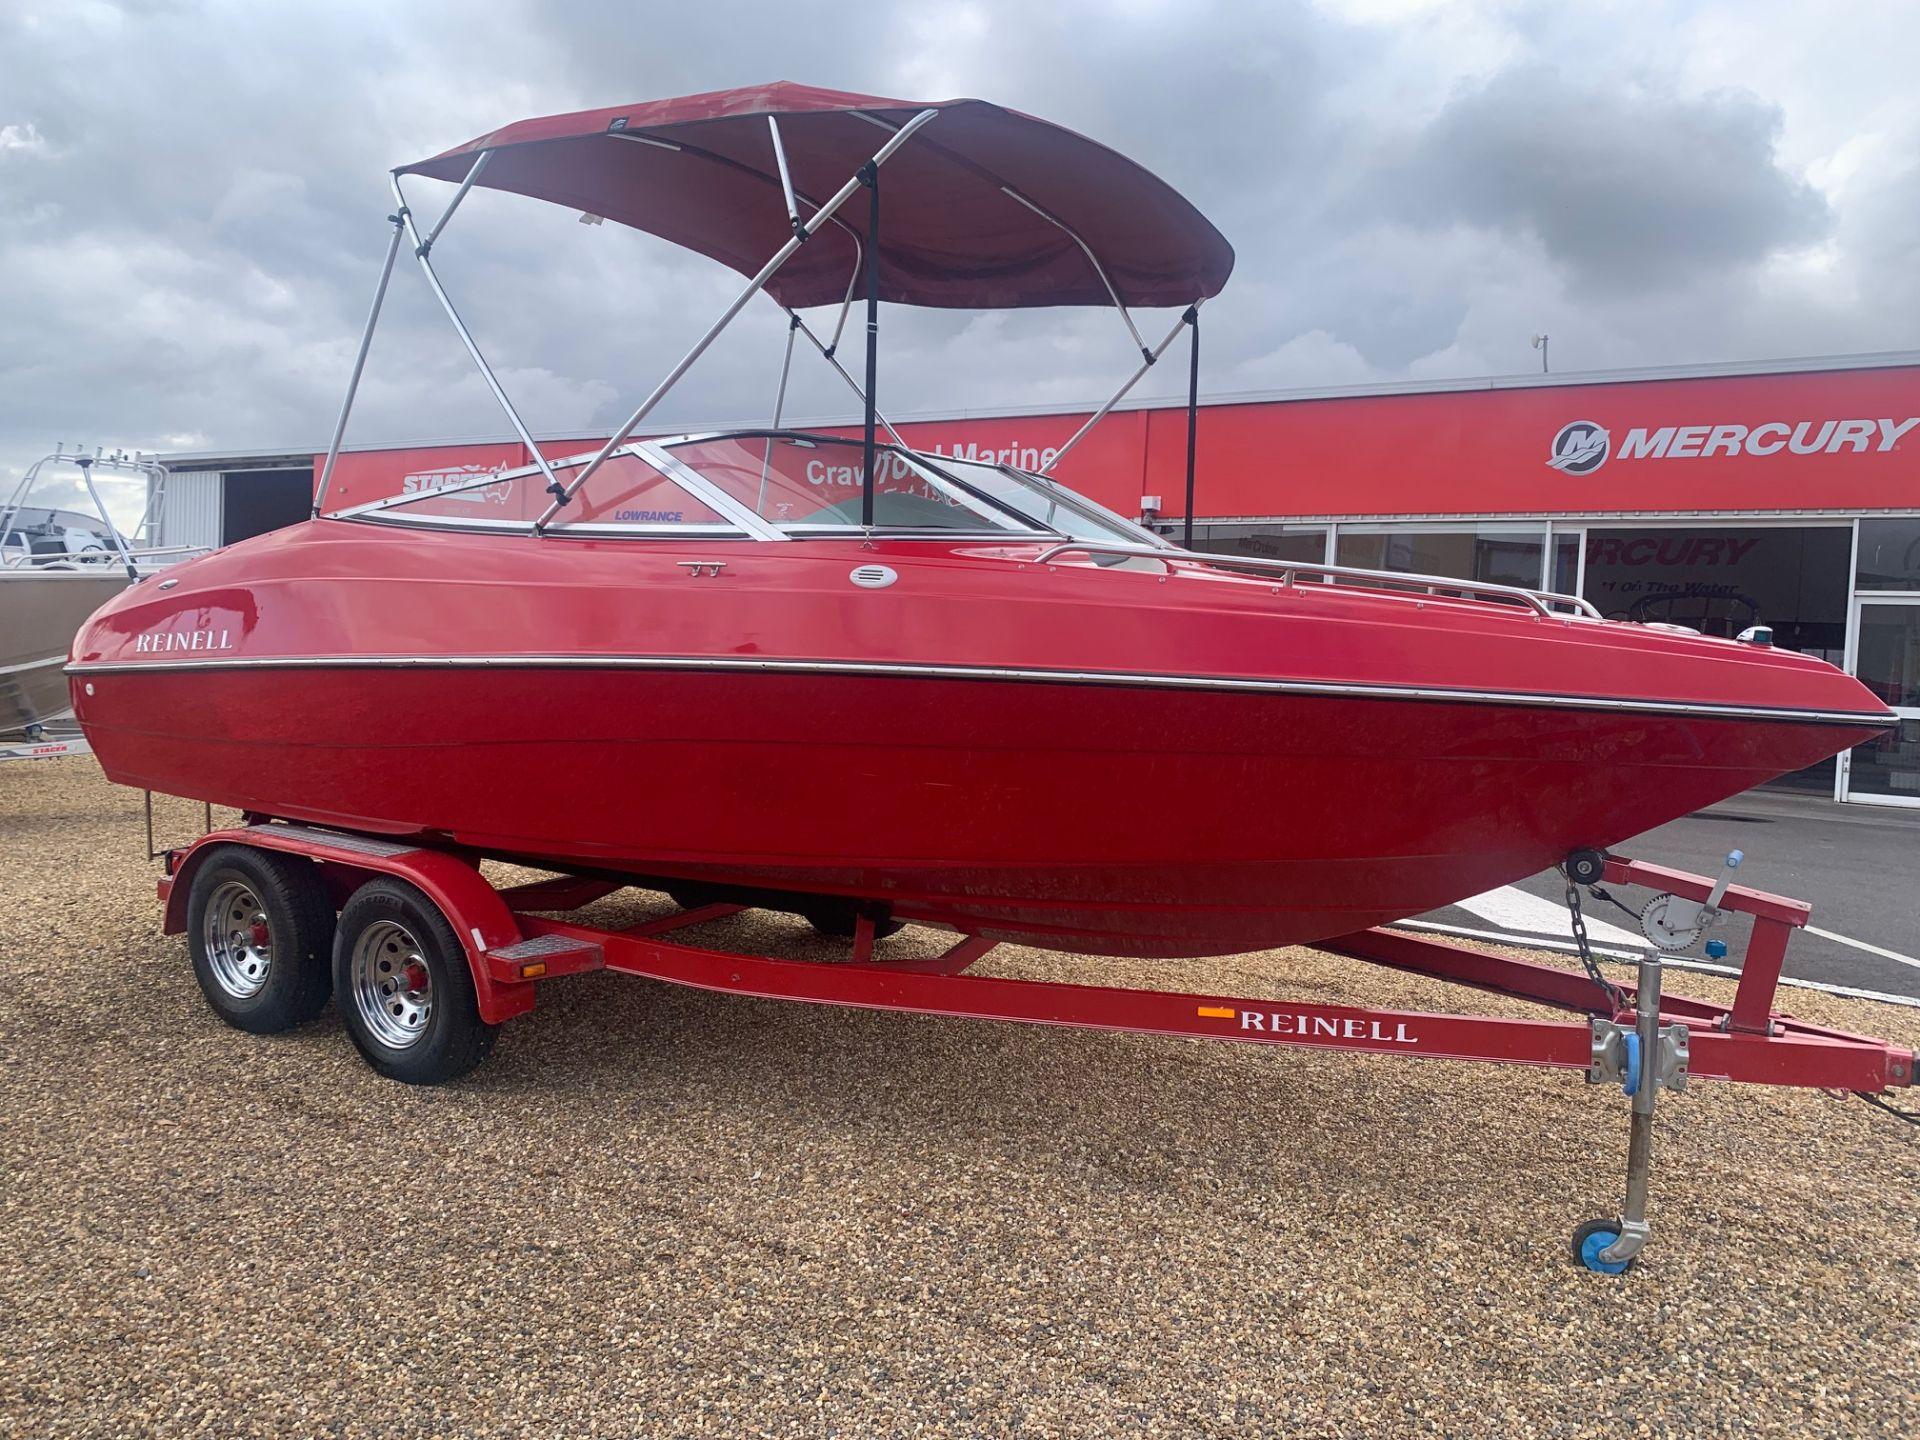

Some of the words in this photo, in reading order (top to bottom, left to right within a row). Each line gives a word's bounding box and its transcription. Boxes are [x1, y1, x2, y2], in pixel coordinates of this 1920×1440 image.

[1616, 418, 1920, 459] MERCURY
[953, 441, 1061, 471] Marine
[614, 510, 683, 521] LOWRANCE
[1647, 582, 1680, 593] The
[1684, 582, 1739, 593] Water
[135, 629, 233, 653] REINELL
[1240, 1010, 1418, 1043] REINELL
